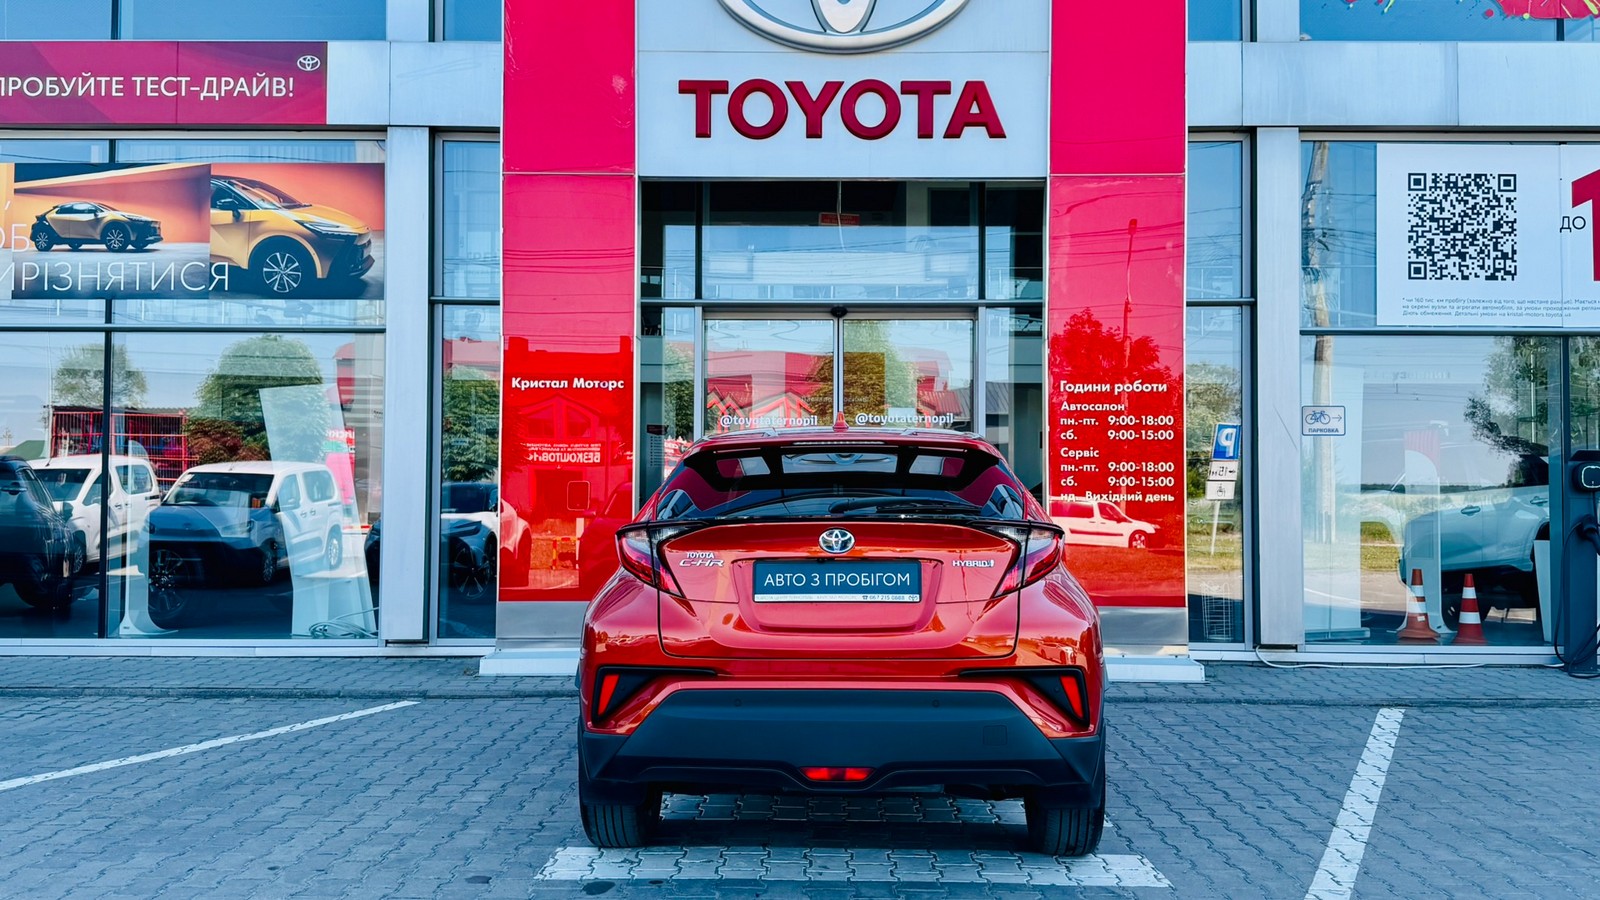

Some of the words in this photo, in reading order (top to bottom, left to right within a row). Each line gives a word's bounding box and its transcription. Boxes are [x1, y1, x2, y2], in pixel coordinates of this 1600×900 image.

[132, 72, 295, 101] ТЕСТ-ДРАЙВ!
[678, 78, 1007, 140] TOYOTA
[511, 377, 568, 391] Кристал
[572, 377, 625, 391] Моторс
[1060, 380, 1111, 393] Години
[1114, 380, 1168, 395] роботи
[1060, 401, 1125, 412] Автосалон
[719, 414, 818, 427] @toyotaternopil
[855, 412, 955, 426] @toyotaternopil
[1060, 417, 1099, 426] пн.-пт.
[1107, 415, 1175, 426] 9:00-18:00
[1060, 430, 1078, 440] сб.
[1107, 430, 1175, 441] 9:00-15:00
[1060, 447, 1100, 460] Сервіс
[1060, 463, 1099, 473] пн.-пт.
[1107, 461, 1175, 473] 9:00-18:00
[1060, 476, 1078, 487] сб.
[1107, 476, 1175, 487] 9:00-15:00
[1085, 490, 1143, 502] Вихідний
[1145, 493, 1175, 503] день
[687, 551, 715, 559] TOYOTA
[679, 559, 725, 567] C-HR
[952, 559, 987, 567] HYBRID
[764, 573, 807, 587] АВТО
[824, 573, 911, 587] ПРОБІГОМ
